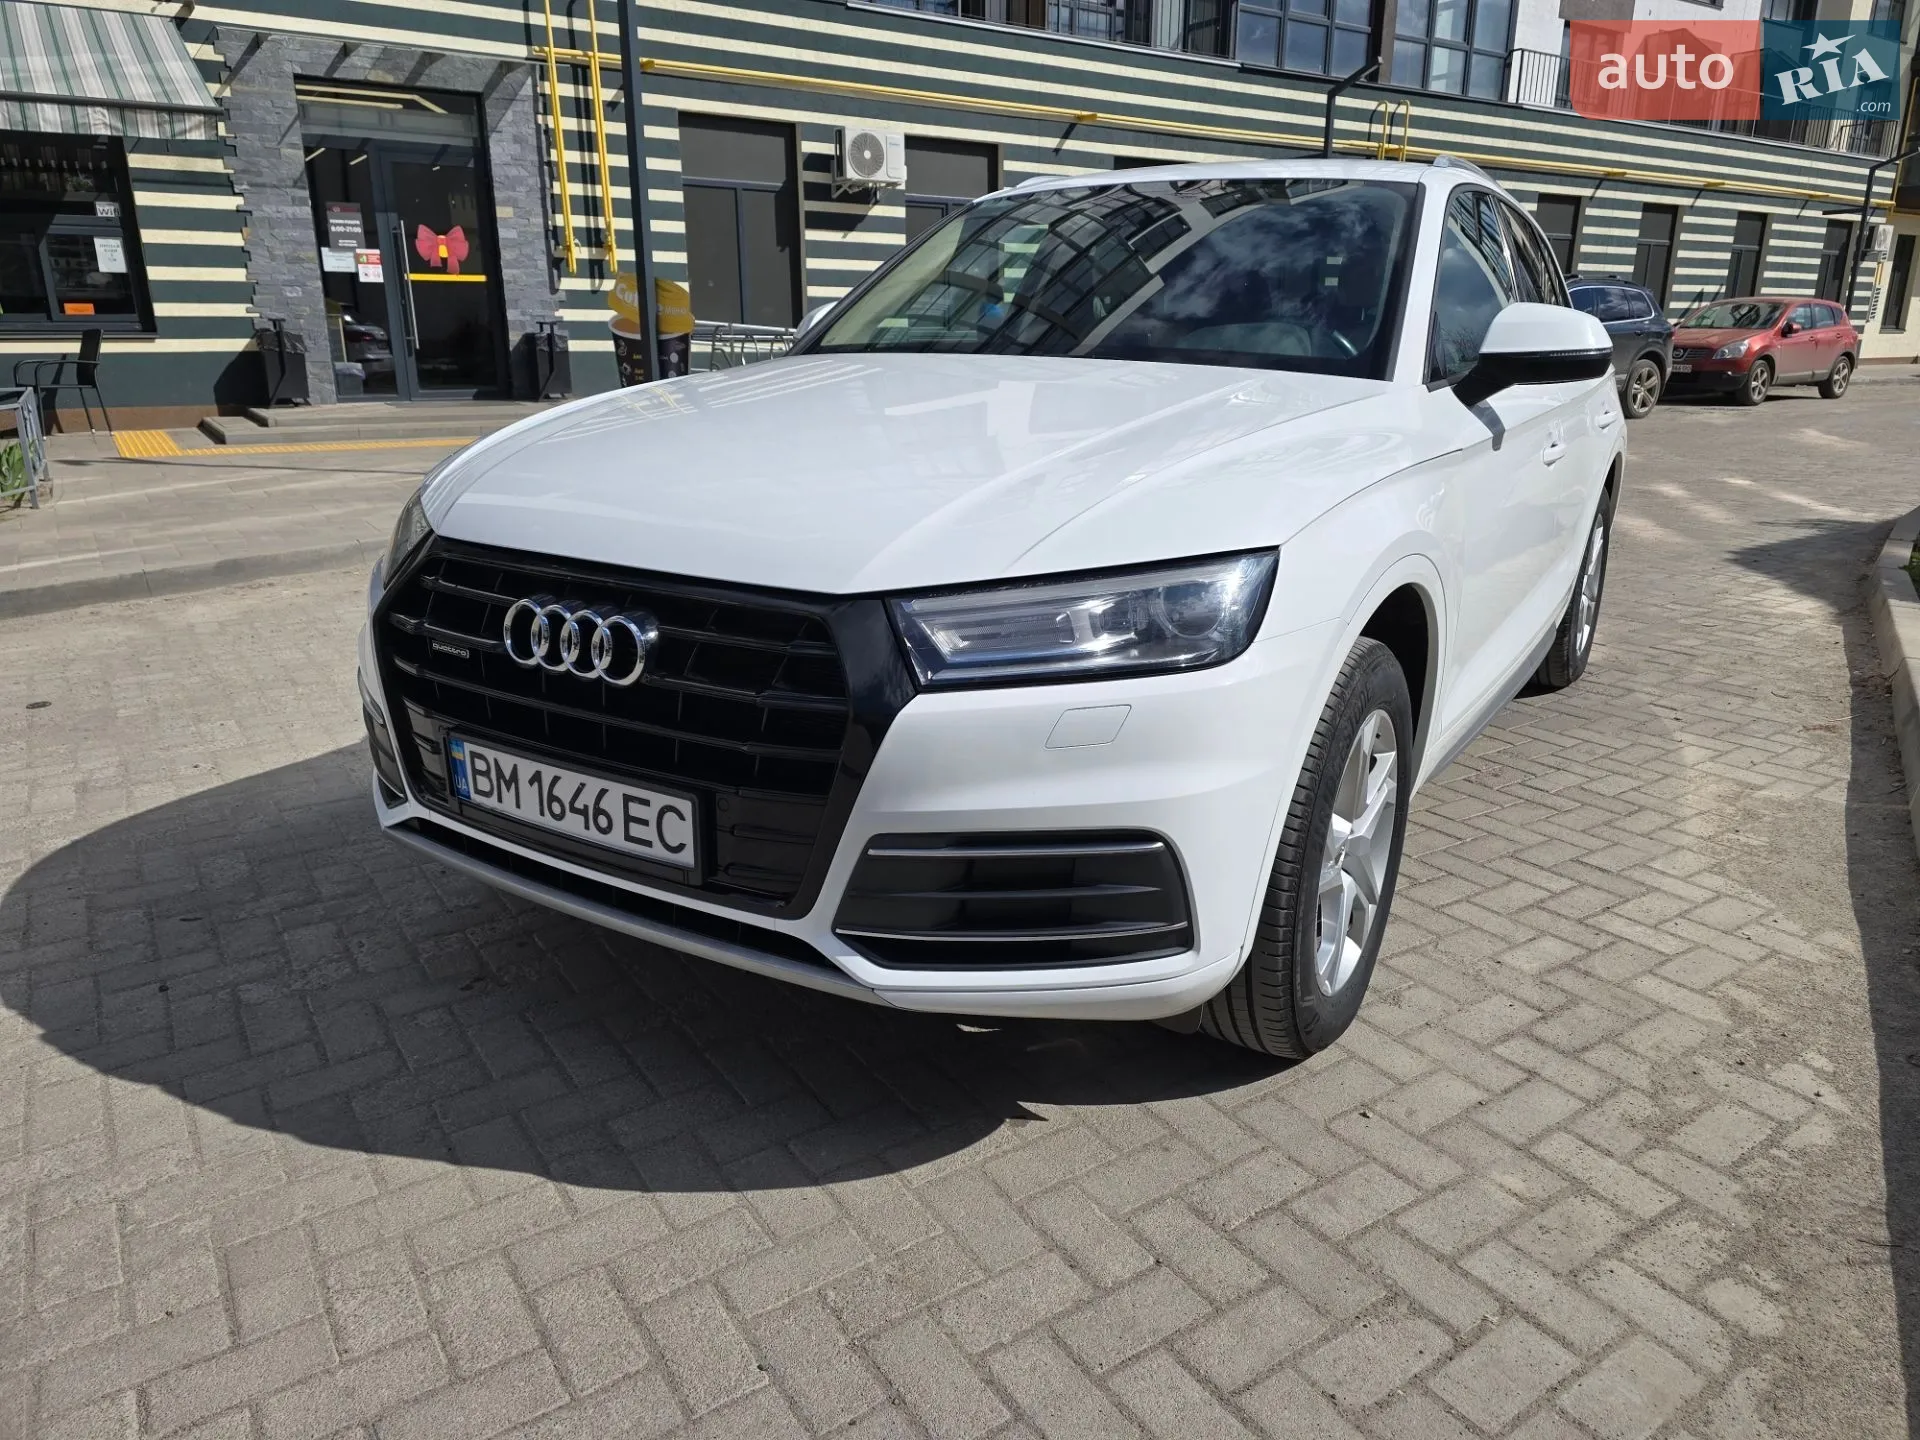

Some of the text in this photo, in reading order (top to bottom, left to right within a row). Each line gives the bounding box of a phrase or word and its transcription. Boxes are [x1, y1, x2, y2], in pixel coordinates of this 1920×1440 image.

[432, 642, 467, 657] quattro
[454, 777, 468, 791] UA
[469, 750, 687, 854] BM 1646 EC
